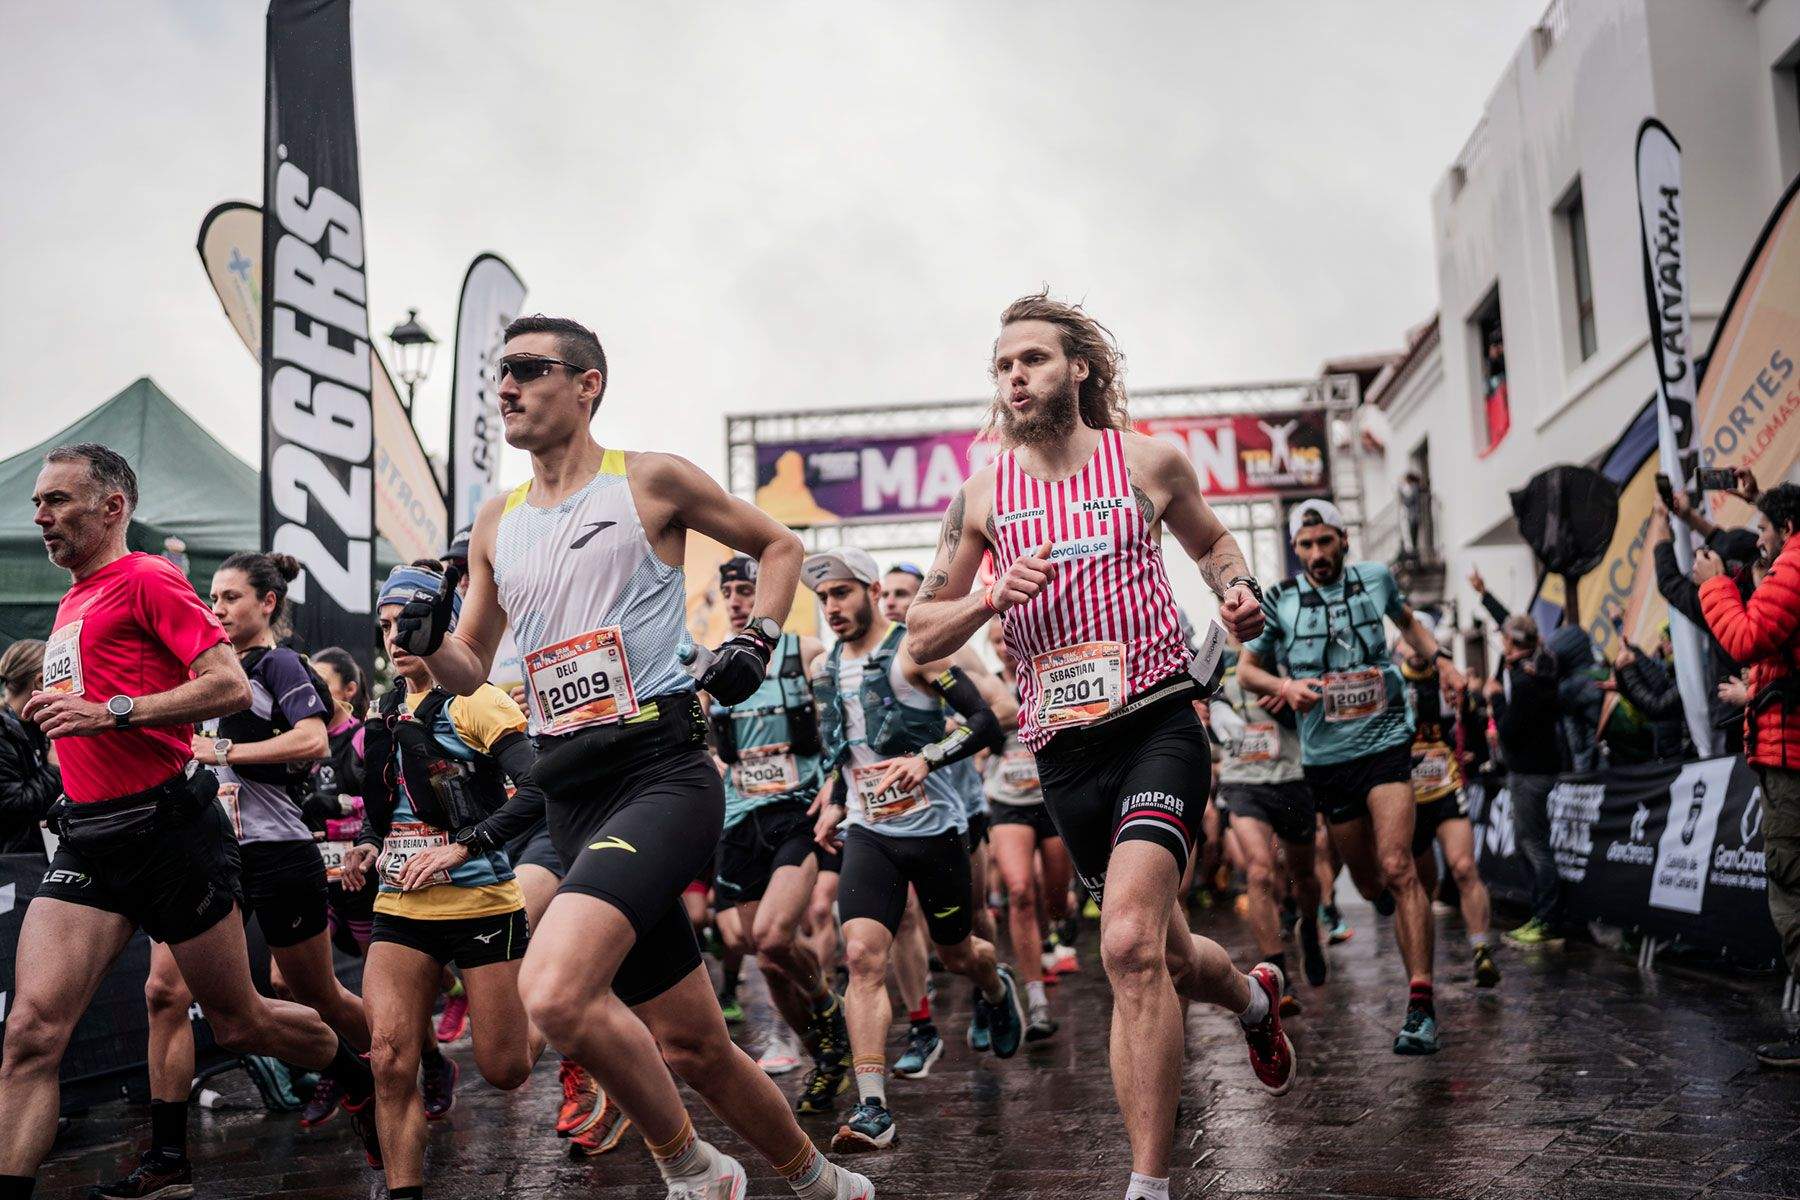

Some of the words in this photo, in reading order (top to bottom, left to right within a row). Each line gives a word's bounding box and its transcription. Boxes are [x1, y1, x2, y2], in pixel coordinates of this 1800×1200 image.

[272, 161, 373, 615] 226ERS
[1083, 499, 1123, 511] HÄLLE
[1004, 509, 1045, 522] noname
[1098, 510, 1110, 520] IF
[556, 661, 578, 679] DELO
[1049, 662, 1095, 682] SEBASTIAN
[548, 671, 610, 709] 2009
[1052, 677, 1104, 704] 2001
[1337, 689, 1375, 705] 2007
[745, 766, 784, 782] 2004
[1131, 791, 1185, 812] IMPAB
